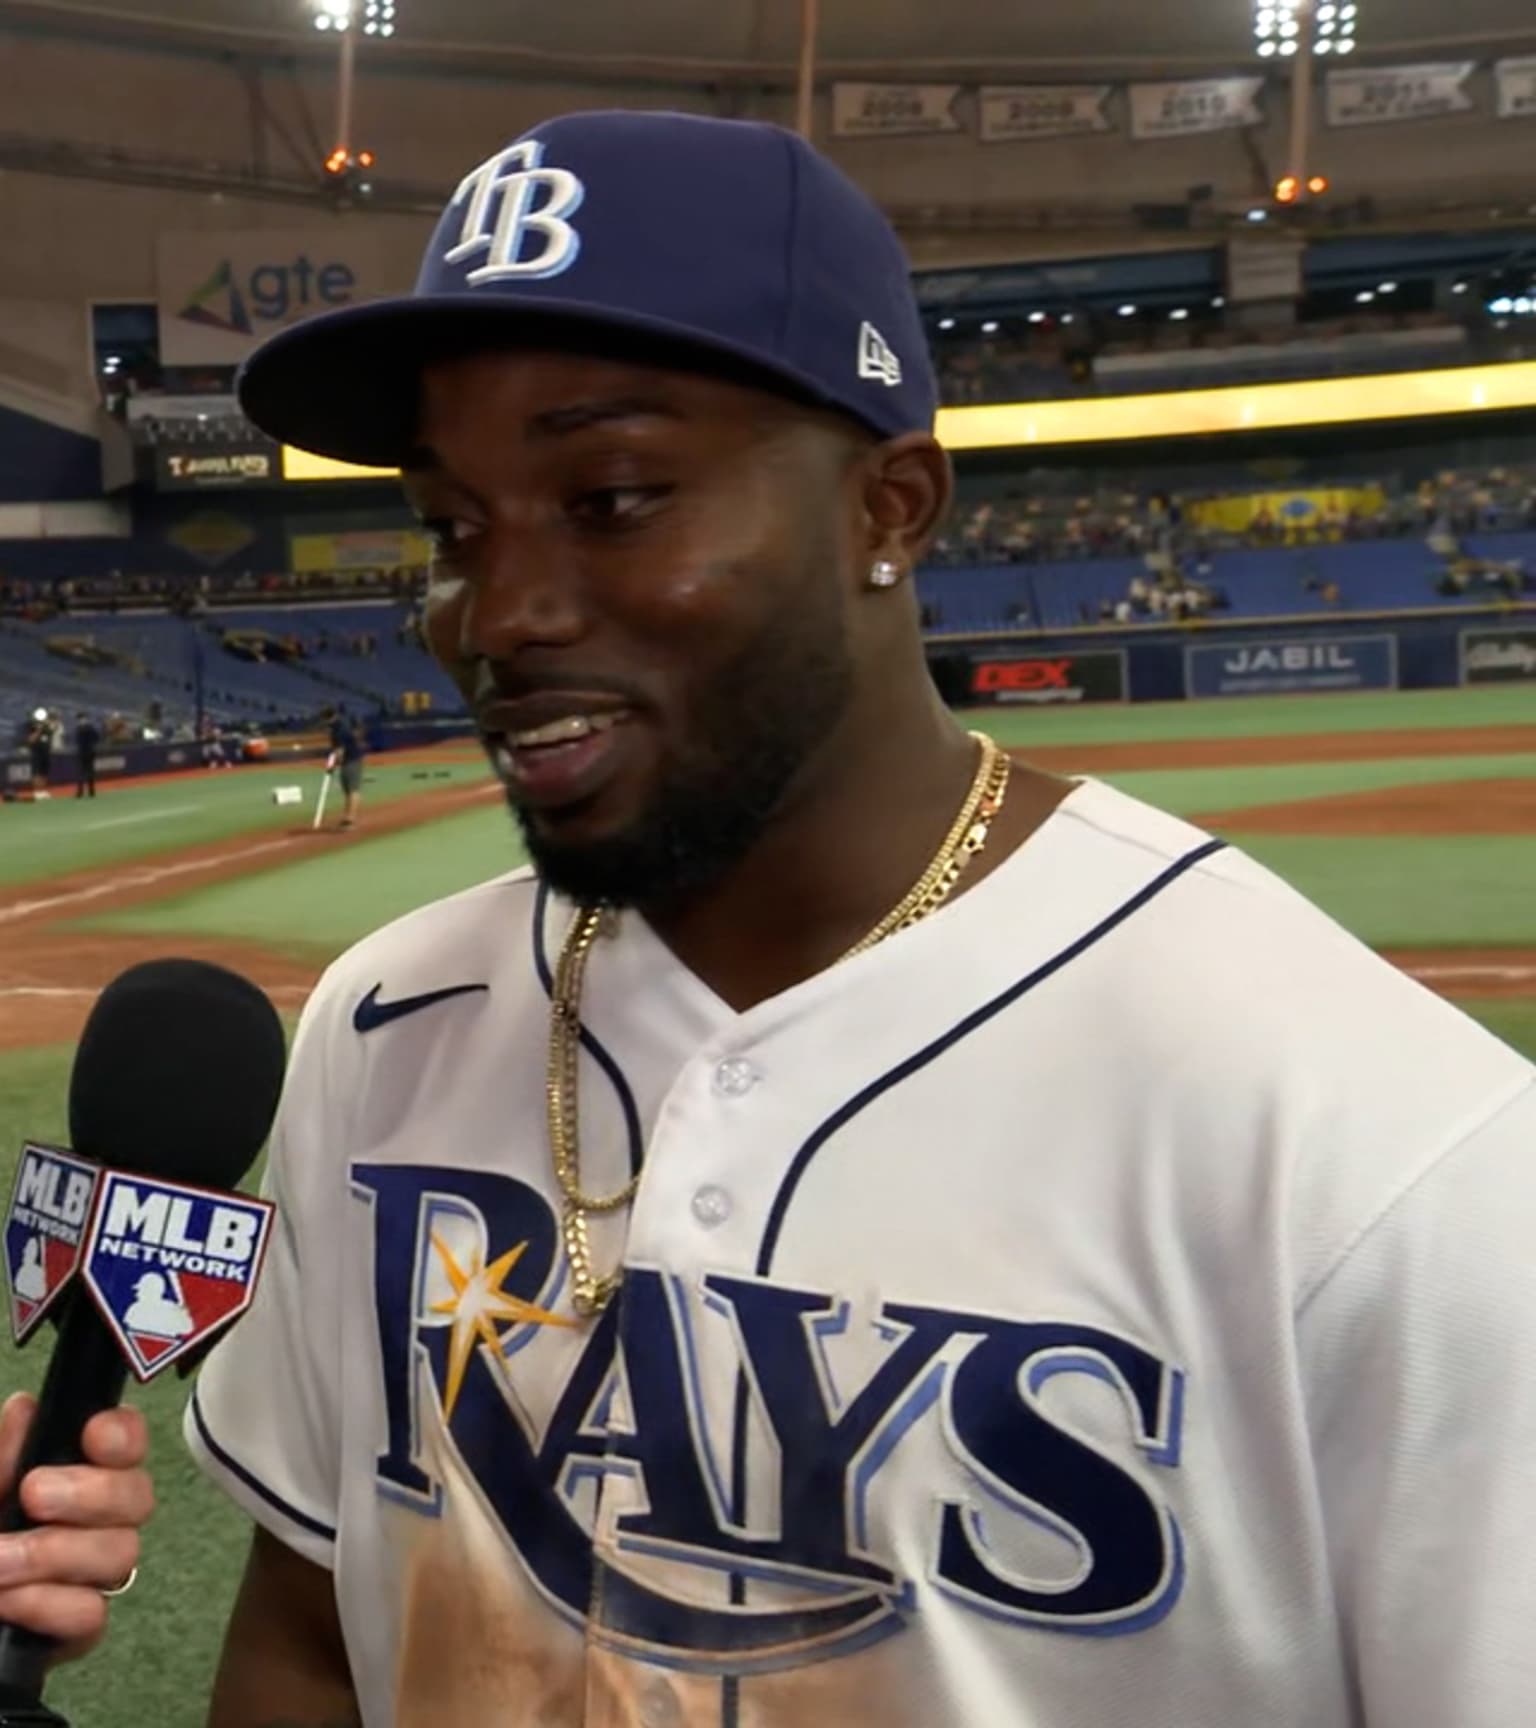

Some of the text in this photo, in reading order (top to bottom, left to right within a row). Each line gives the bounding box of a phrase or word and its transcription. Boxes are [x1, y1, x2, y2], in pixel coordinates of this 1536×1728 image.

[444, 139, 584, 288] TB
[249, 255, 355, 319] gte
[972, 658, 1075, 692] DEX
[1224, 644, 1355, 673] JABIL
[19, 1155, 93, 1225] MLB
[14, 1206, 80, 1240] NETWORK
[104, 1184, 259, 1262] MLB
[99, 1238, 246, 1282] NETWORK
